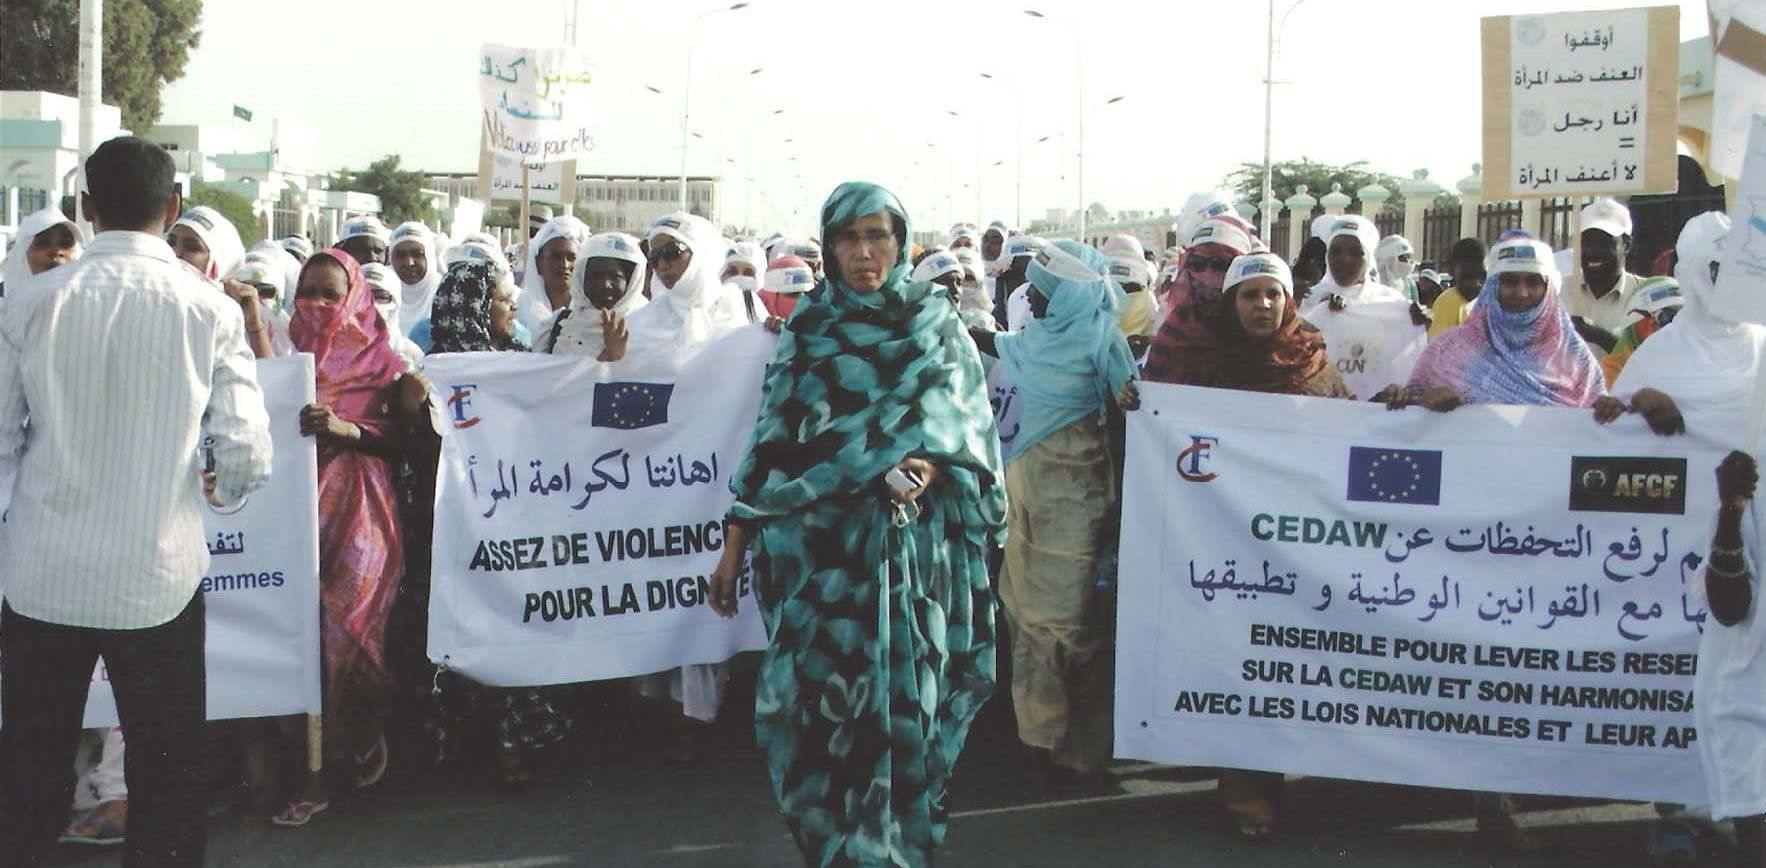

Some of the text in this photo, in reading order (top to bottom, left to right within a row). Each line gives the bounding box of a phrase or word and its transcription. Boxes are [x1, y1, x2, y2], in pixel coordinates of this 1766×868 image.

[1564, 25, 1614, 52] أوقفوا
[1513, 65, 1643, 90] العنف ضد المرأة
[1552, 103, 1639, 133] أنا رجل
[1518, 159, 1638, 190] لا أعنف المرأة
[467, 454, 518, 519] المرأ
[1613, 474, 1678, 498] AFCF
[1250, 513, 1388, 549] CEDAW
[1384, 527, 1434, 563] عن
[468, 536, 548, 572] ASSEZ
[552, 533, 590, 566] DE
[1602, 526, 1669, 583] لرفع
[202, 570, 285, 593] emmes
[1189, 559, 1298, 602] تطبيقها
[1312, 583, 1332, 611] و
[1347, 571, 1460, 623] الوطنية
[522, 587, 596, 624] POUR
[602, 583, 641, 616] LA
[1477, 583, 1600, 630] القوانين
[1617, 601, 1662, 642] مع
[1250, 624, 1387, 657] ENSEMBLE
[1393, 638, 1467, 665] POUR
[1474, 644, 1559, 671] LEVER
[1566, 650, 1616, 674] LES
[1241, 659, 1294, 685] SUR
[1300, 663, 1333, 688] LA
[1339, 668, 1433, 697] CEDAW
[1438, 677, 1472, 701] ET
[1478, 680, 1533, 705] SON
[1174, 690, 1698, 749] AVEC LES LOIS NATIONALES ET LEUR AP
